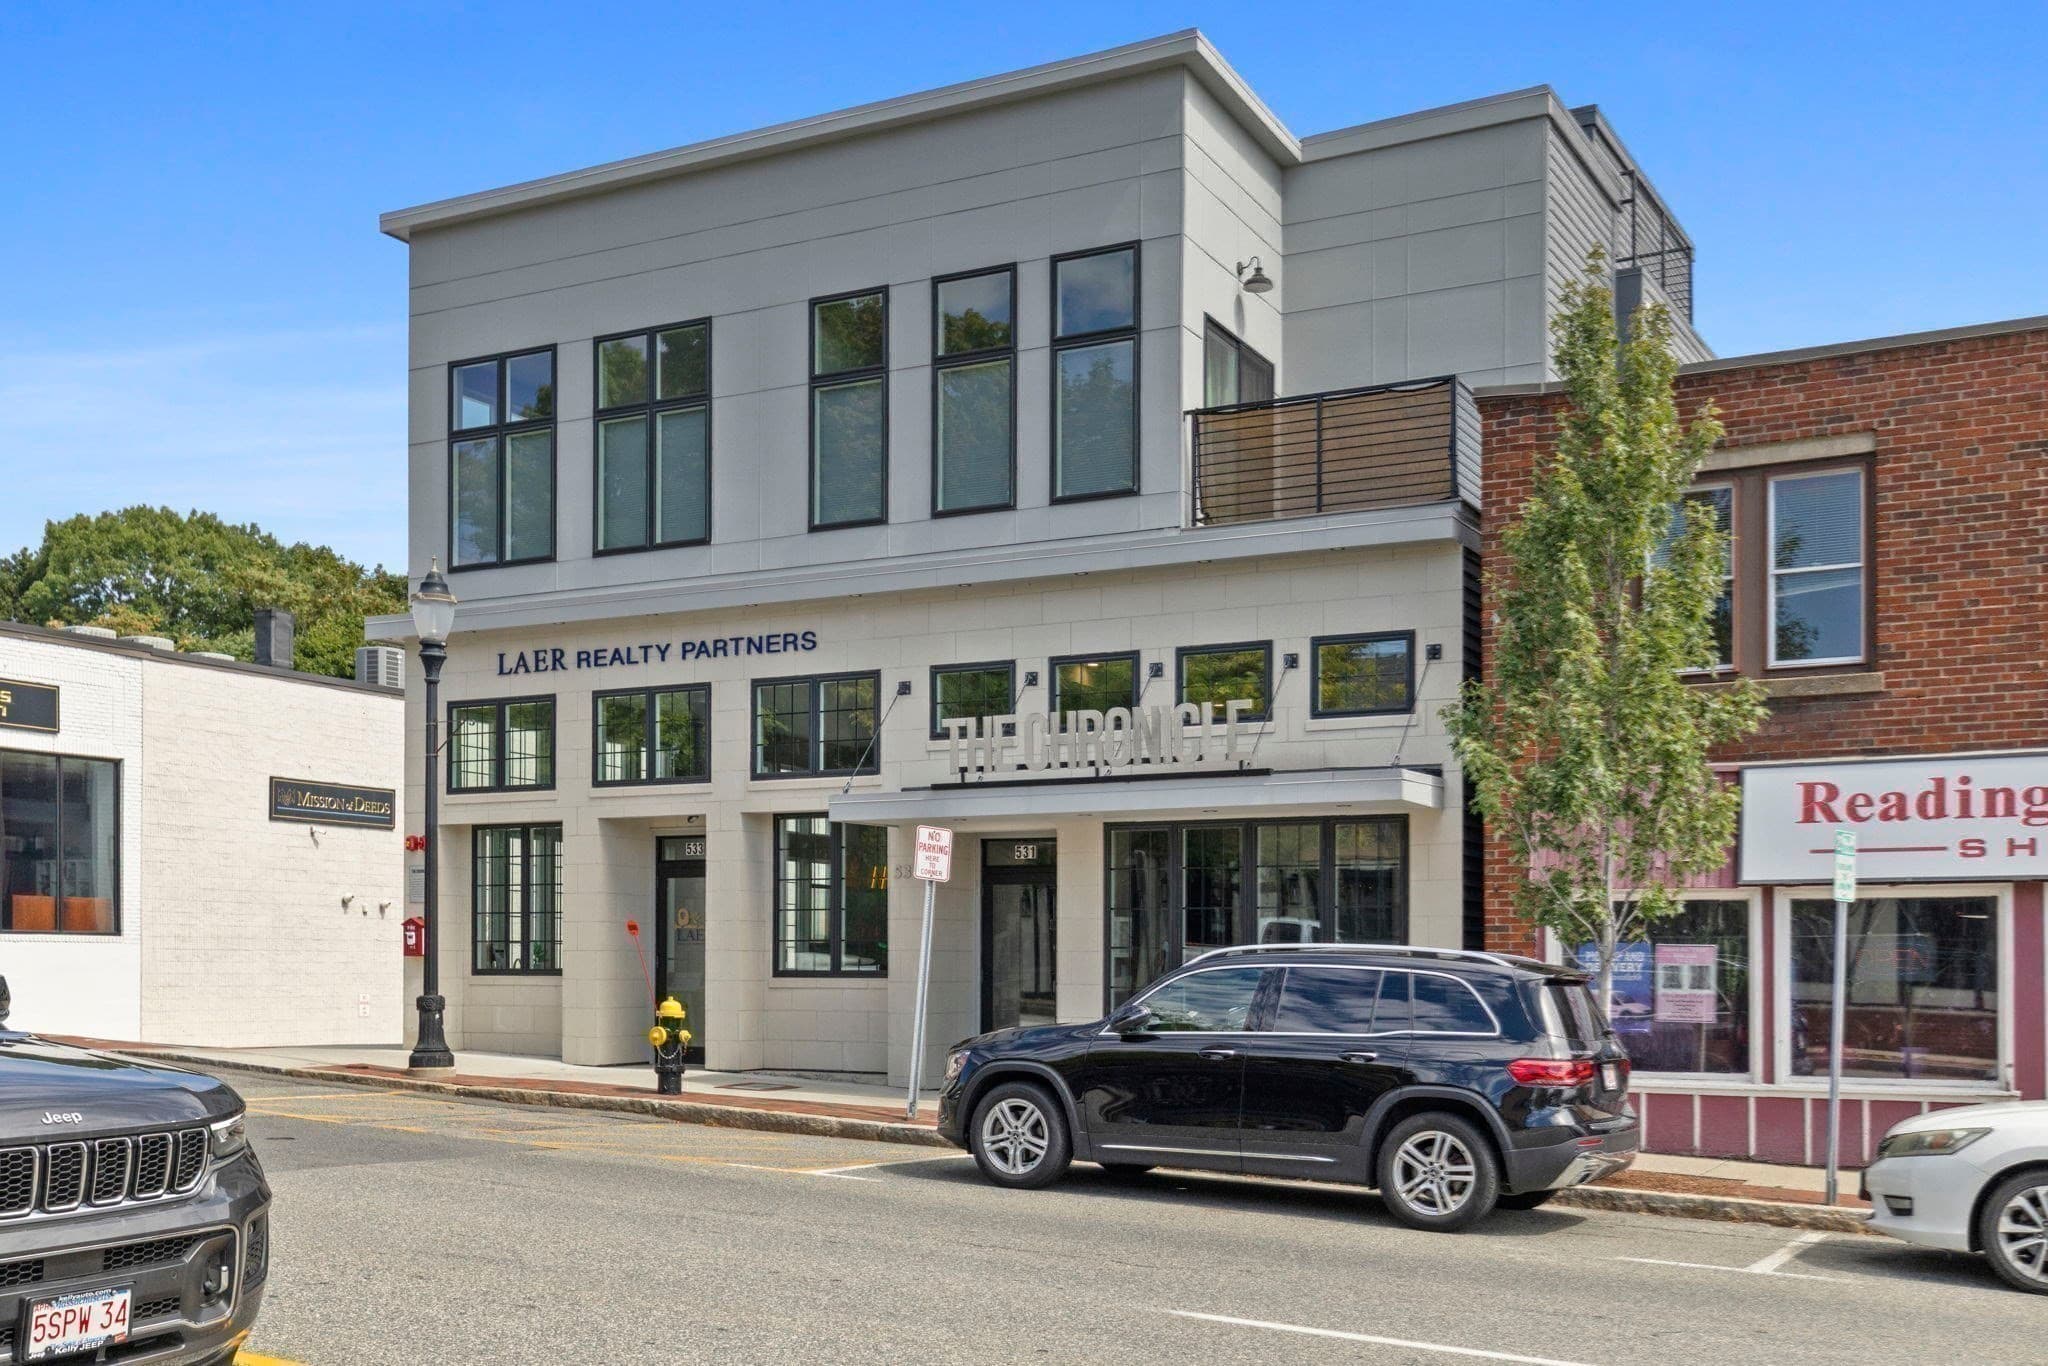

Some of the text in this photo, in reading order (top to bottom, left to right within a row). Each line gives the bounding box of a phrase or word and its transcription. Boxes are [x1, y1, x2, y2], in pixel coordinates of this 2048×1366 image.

[497, 631, 818, 676] LAER REALTY PARTNERS
[942, 698, 1253, 775] THE CHRONICLE
[297, 791, 345, 811] MISSION
[354, 796, 391, 814] DEEDS
[1794, 775, 2048, 827] Reading
[927, 831, 941, 842] NO
[686, 843, 704, 855] 533
[918, 841, 949, 855] PARKING
[1014, 845, 1037, 859] 531
[920, 868, 943, 877] CORNER
[41, 1111, 83, 1124] Jeep
[33, 1298, 127, 1343] 5SPW 34
[54, 1345, 78, 1355] Kelly
[79, 1340, 104, 1351] JEEP
